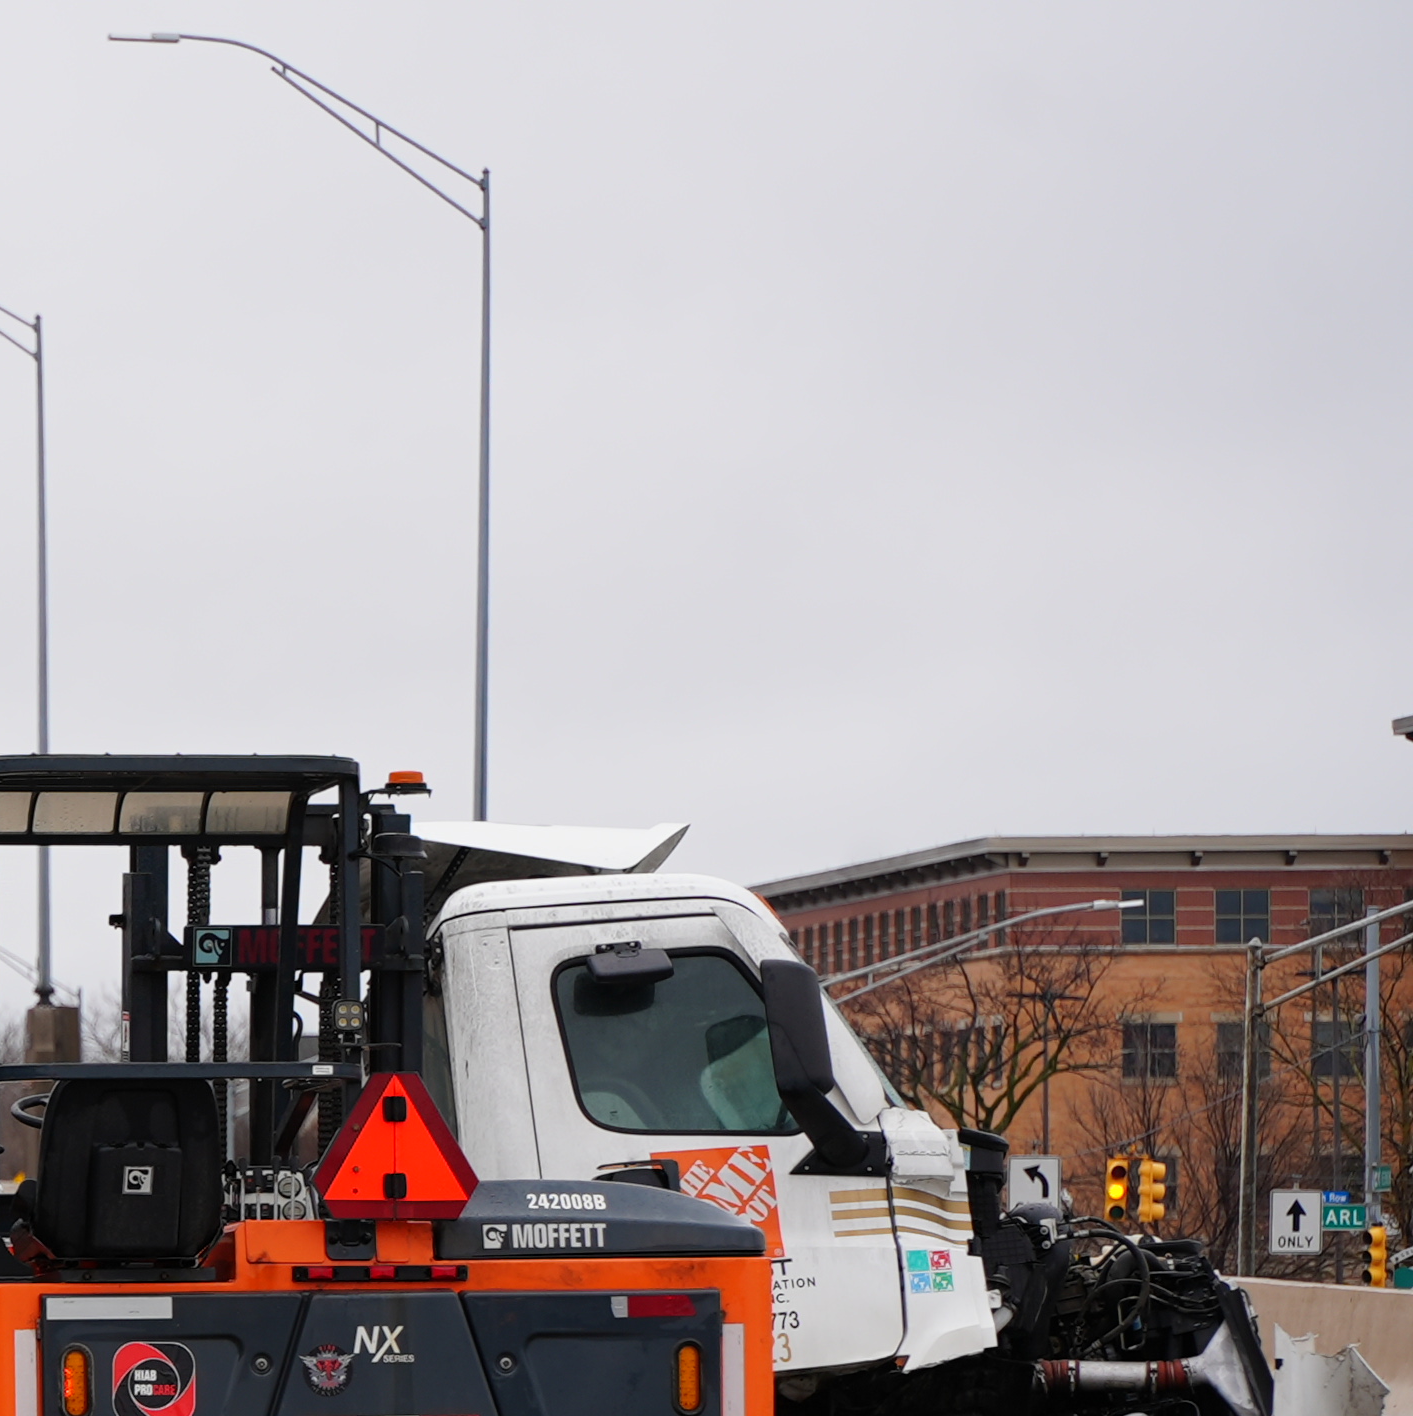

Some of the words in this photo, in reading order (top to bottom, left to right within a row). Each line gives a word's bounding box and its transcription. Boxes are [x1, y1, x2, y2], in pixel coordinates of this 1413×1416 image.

[526, 1193, 607, 1210] 242008B
[1322, 1209, 1364, 1226] ARL
[511, 1223, 607, 1249] MOFFETT
[1277, 1236, 1313, 1248] ONLY
[773, 1277, 816, 1290] ATION
[354, 1325, 404, 1363] NX
[382, 1354, 415, 1363] SERIES
[134, 1369, 157, 1381] HIAB
